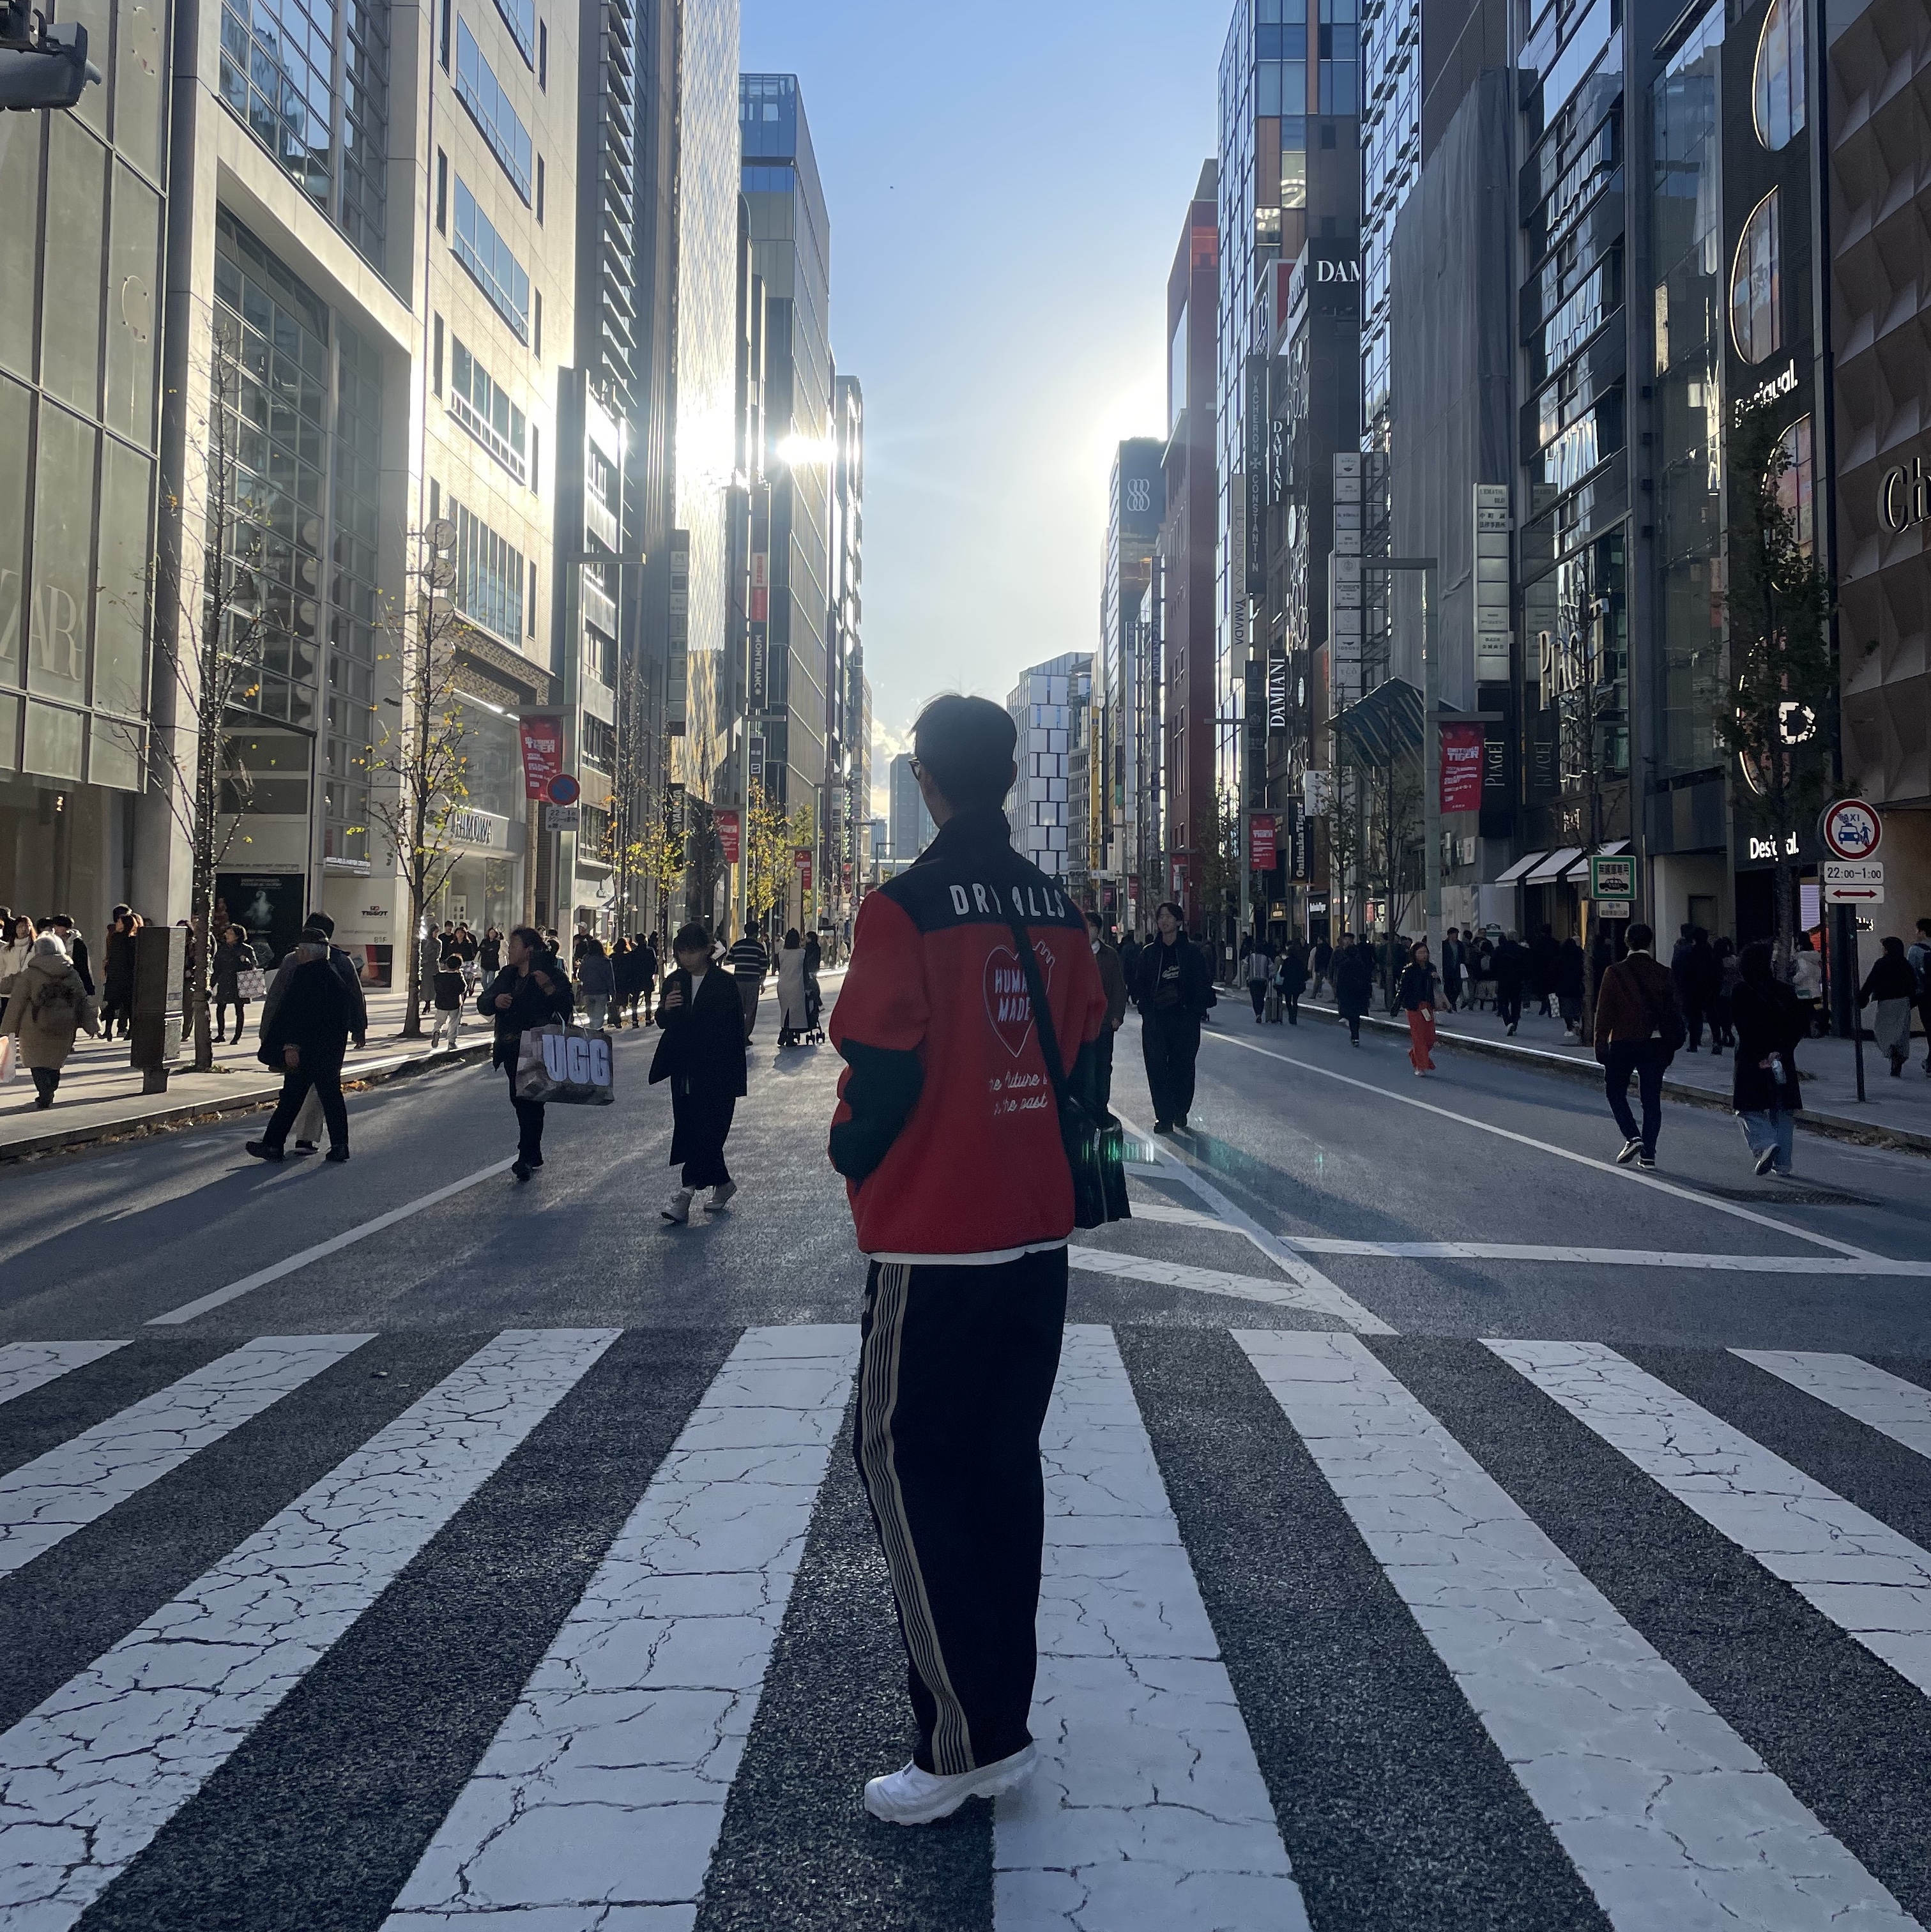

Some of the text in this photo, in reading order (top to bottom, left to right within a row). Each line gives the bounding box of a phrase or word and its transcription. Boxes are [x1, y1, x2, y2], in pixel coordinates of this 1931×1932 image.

[1272, 420, 1283, 503] DAMIANI
[1251, 474, 1260, 573] CONSTANTIN
[1235, 598, 1246, 646] YAMADA
[754, 634, 763, 689] MONTBLANC
[1269, 658, 1285, 727] DAMIANI
[1483, 738, 1506, 787] PIAGET
[997, 997, 1032, 1023] MADE
[542, 1033, 611, 1086] UGG
[1019, 1091, 1048, 1114] past
